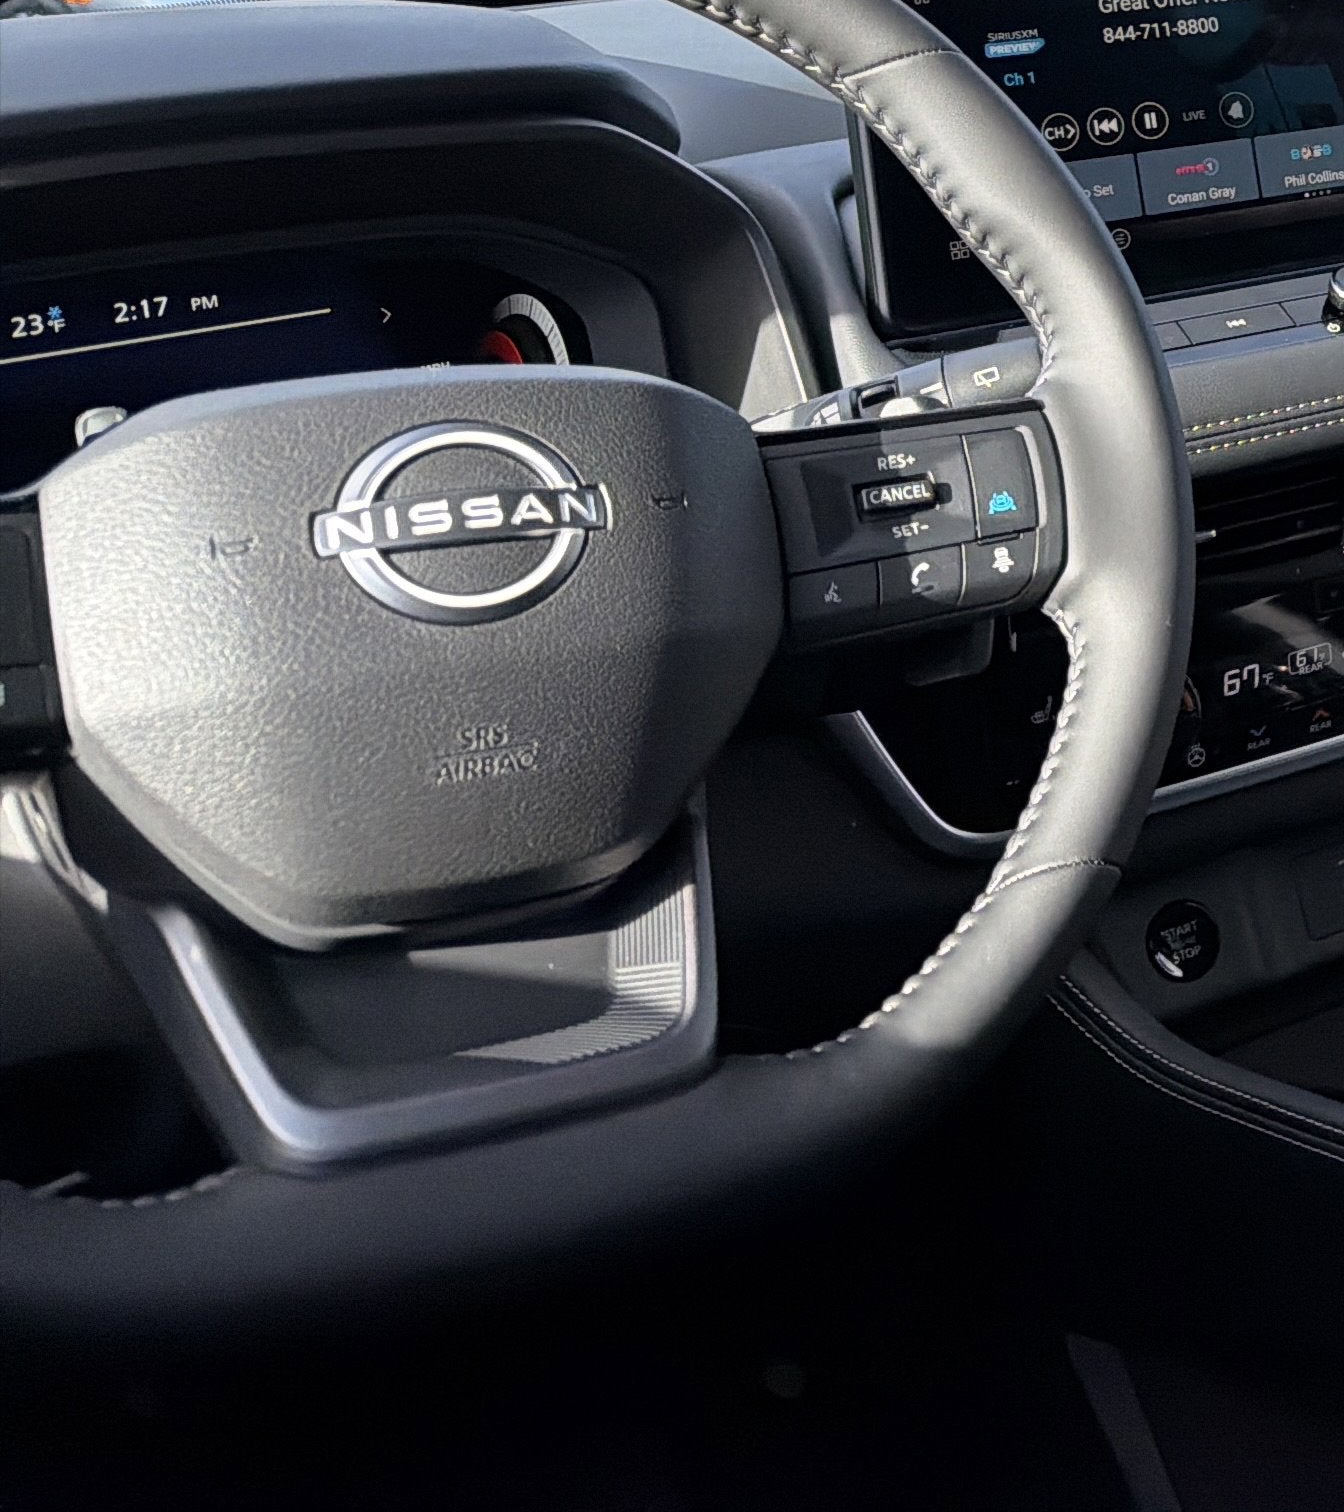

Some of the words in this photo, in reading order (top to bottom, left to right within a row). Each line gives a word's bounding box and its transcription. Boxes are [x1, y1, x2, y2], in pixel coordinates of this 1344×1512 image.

[987, 28, 1039, 42] SIRIUSXM
[1102, 16, 1220, 44] 844-711-8800
[988, 40, 1041, 55] PREVIEW
[1003, 72, 1025, 87] Ch
[1027, 71, 1036, 85] 1
[1182, 109, 1207, 122] LIVE
[1284, 174, 1306, 189] Phil
[1092, 184, 1114, 197] Set
[1168, 189, 1208, 206] Conan
[1209, 186, 1237, 204] Gray
[113, 296, 169, 324] 2:17
[190, 295, 219, 312] PM
[877, 454, 916, 471] RES+
[868, 484, 931, 504] CANCEL
[323, 490, 598, 550] NISSAN
[892, 522, 930, 538] SET-
[1299, 662, 1323, 675] REAR
[1309, 720, 1332, 732] REAR
[456, 723, 509, 750] SRS
[1247, 738, 1271, 751] REAR
[437, 742, 538, 786] AIRBAG
[1160, 920, 1197, 939] START
[1172, 945, 1201, 965] STOP
